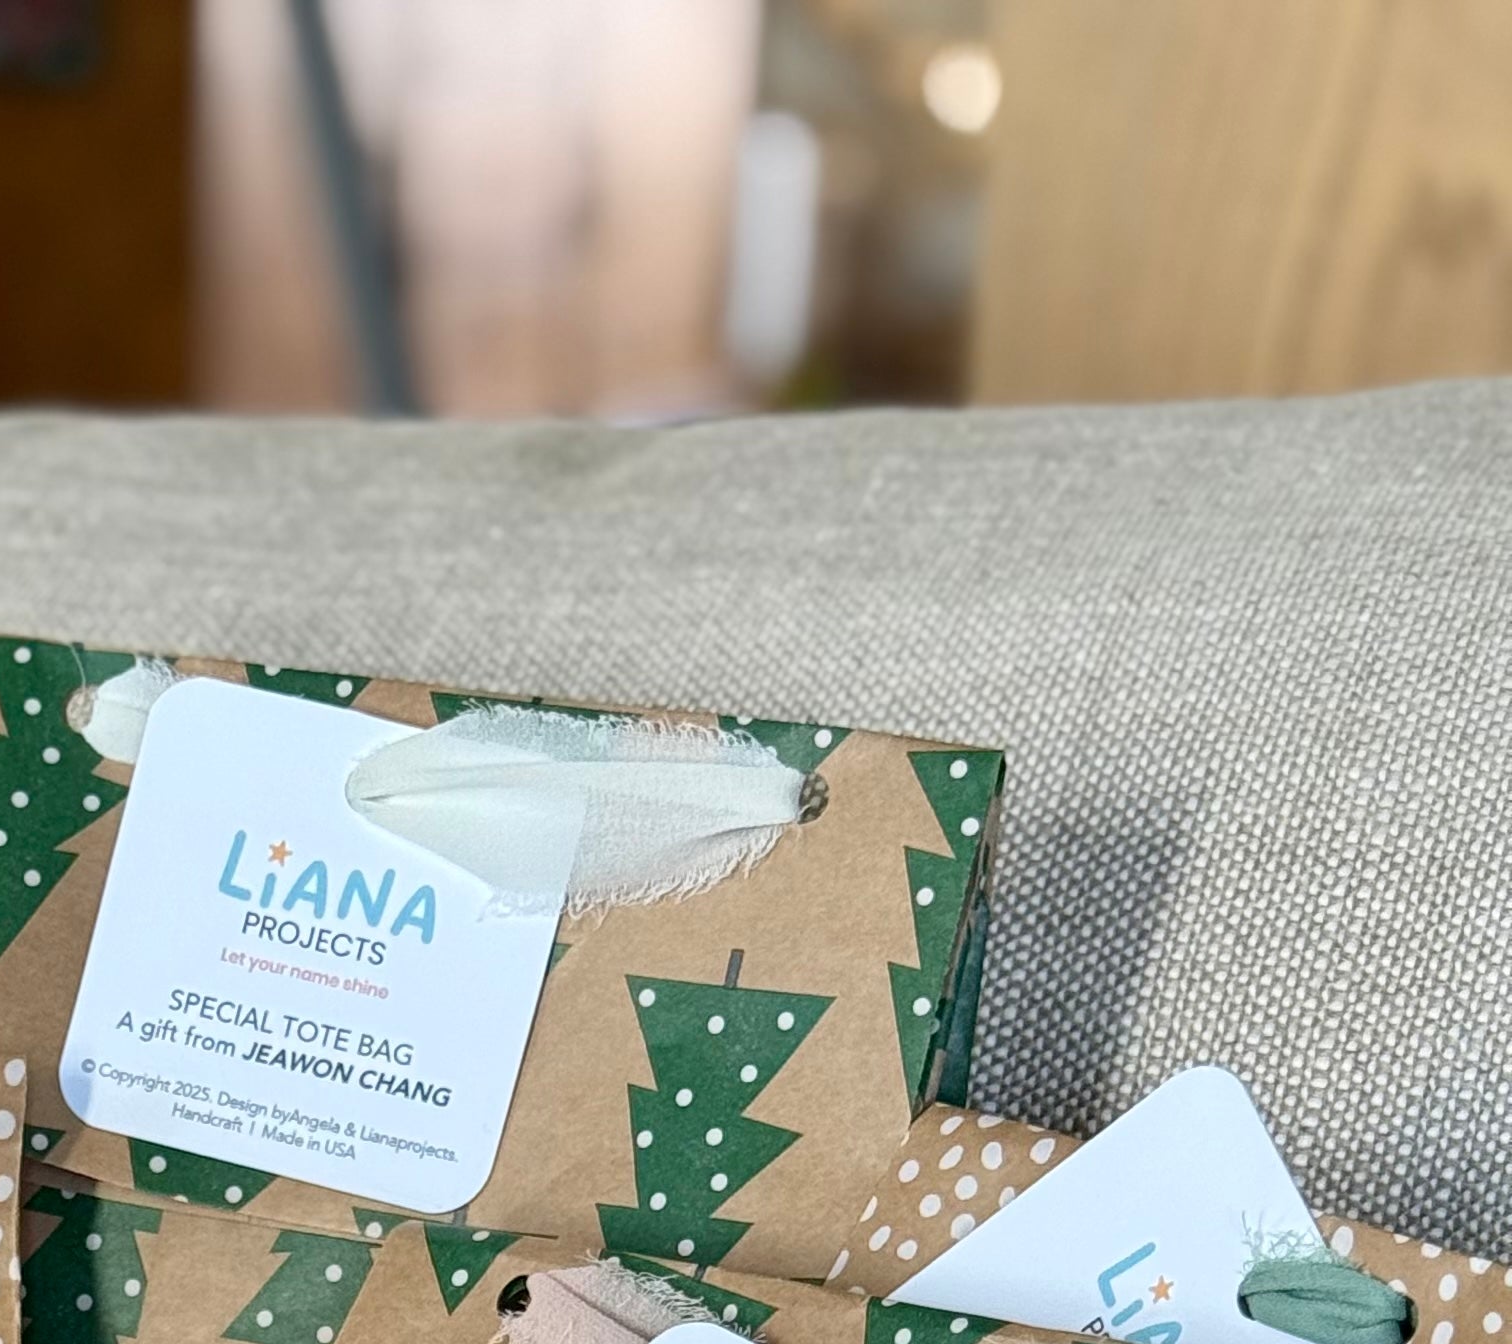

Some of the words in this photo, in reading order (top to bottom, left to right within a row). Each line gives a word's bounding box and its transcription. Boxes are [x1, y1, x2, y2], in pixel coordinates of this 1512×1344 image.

[241, 911, 387, 965] PROJECTS
[220, 947, 245, 965] Let
[248, 954, 288, 976] your
[290, 965, 340, 988] name
[343, 977, 390, 1000] shine
[116, 1011, 134, 1032] A
[140, 1019, 178, 1043] gift
[184, 1026, 236, 1058] from
[242, 1042, 354, 1085] JEAWON
[358, 1069, 453, 1107] CHANG
[169, 989, 274, 1034] SPECIAL
[283, 1015, 352, 1052] TOTE
[357, 1034, 415, 1066] BAG
[98, 1061, 172, 1094] Copyright
[172, 1080, 212, 1102] 2025.
[217, 1091, 268, 1118] Design
[343, 1122, 357, 1137] &
[172, 1102, 243, 1133] Handcraft
[262, 1124, 304, 1148] Made
[307, 1137, 321, 1151] in
[324, 1137, 356, 1160] USA
